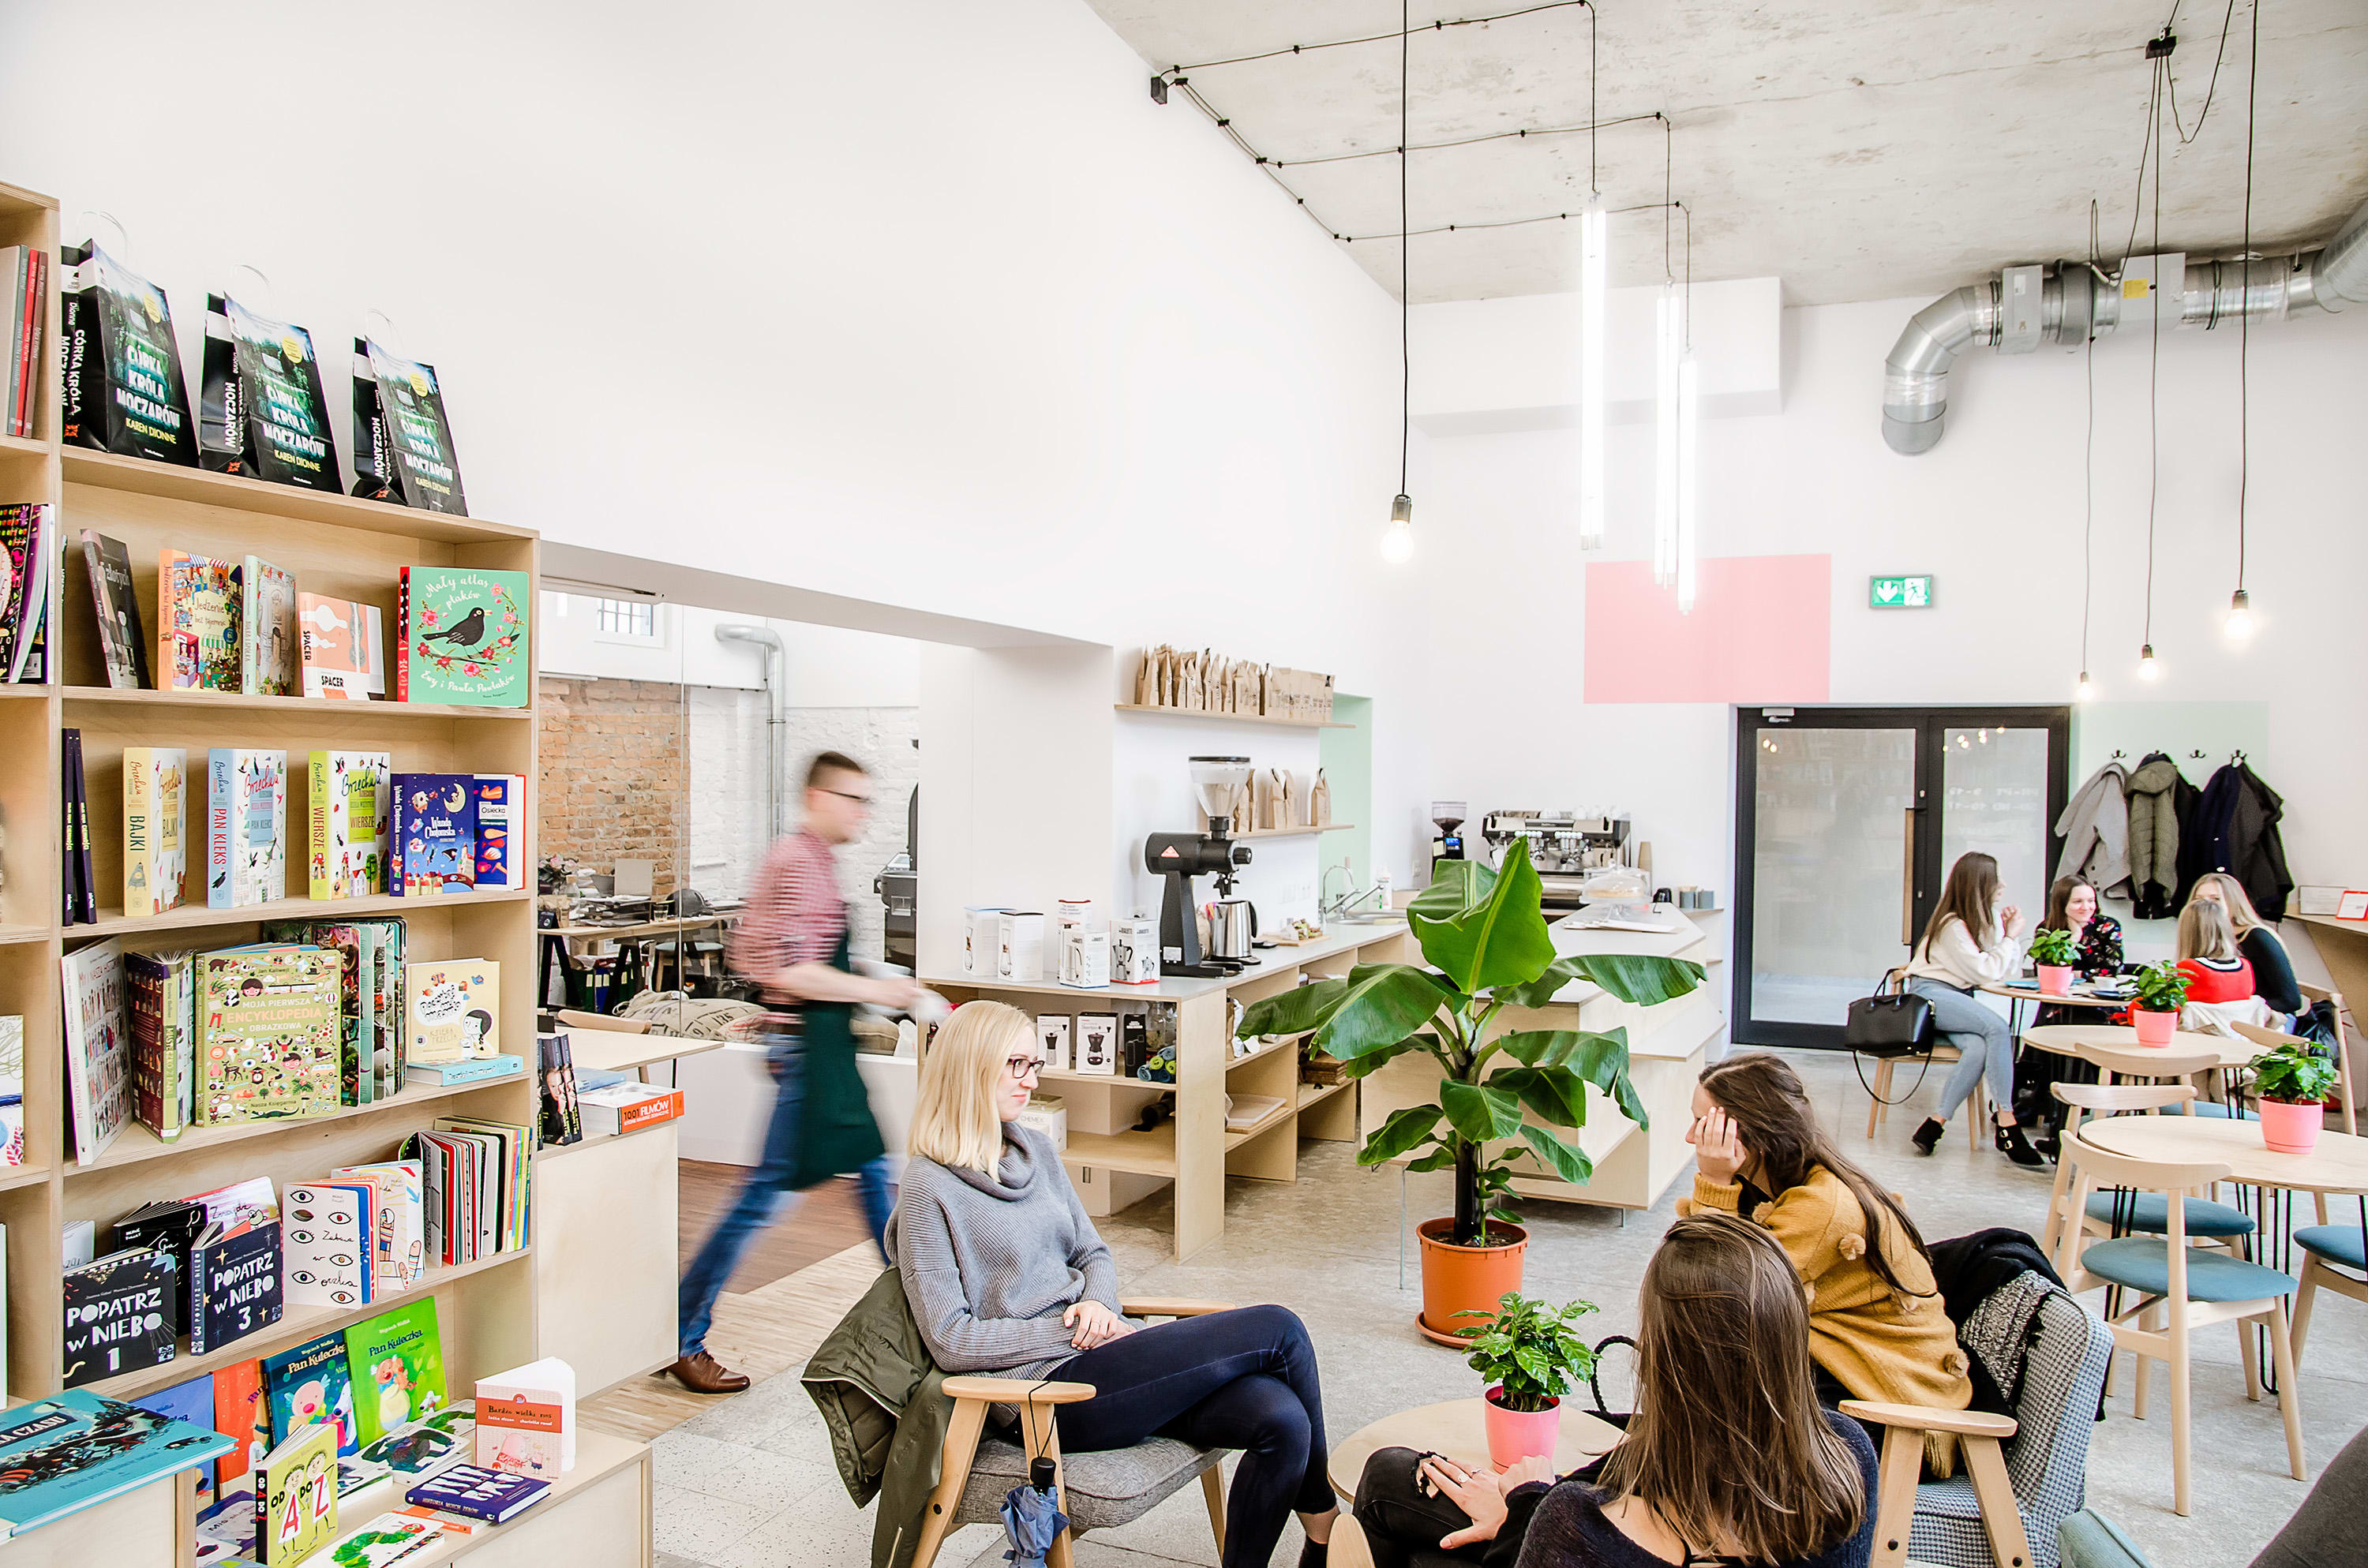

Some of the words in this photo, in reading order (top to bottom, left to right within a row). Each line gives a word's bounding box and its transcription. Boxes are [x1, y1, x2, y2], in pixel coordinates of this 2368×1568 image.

[72, 329, 85, 369] CÓRKA
[126, 345, 163, 376] CÓRKA
[127, 369, 165, 399] KRÓLA
[116, 387, 180, 428] MOCZARÓW
[225, 382, 237, 449] MOCZARÓW
[272, 406, 310, 434] KRÓLA
[126, 416, 148, 435] KAREN
[148, 424, 178, 444] DIONNE
[262, 423, 325, 458] MOCZARÓW
[274, 449, 296, 465] KAREN
[296, 456, 321, 472] DIONNE
[371, 417, 385, 478] MOCZARÓW
[404, 453, 453, 481] MOCZARÓW
[425, 574, 456, 598] Mały
[460, 574, 489, 588] atlas
[195, 597, 225, 614] Jedzenie
[446, 589, 481, 610] ptaków
[303, 630, 312, 661] SPACER
[321, 675, 344, 688] SPACER
[421, 670, 438, 689] Ewy
[440, 679, 444, 688] i
[448, 681, 474, 692] Pawła
[477, 674, 515, 693] Pawlaków
[214, 761, 229, 793] Brzechwa
[244, 765, 280, 798] Brzechwa
[314, 762, 323, 793] Brzechwa
[341, 766, 382, 797] Brzechwa
[394, 785, 403, 804] Wanda
[214, 808, 227, 829] PAN
[313, 807, 325, 849] WIERSZE
[350, 816, 375, 828] WIERSZE
[430, 817, 452, 829] Wanda
[129, 816, 145, 851] BAJKI
[424, 826, 456, 838] Chotomska
[214, 834, 227, 865] KLEKS
[268, 998, 311, 1007] PIERWSZA
[227, 1008, 322, 1024] ENCYKLOPEDIA
[249, 1022, 301, 1033] OBRAZKOWA
[712, 1012, 734, 1026] 135
[165, 1027, 174, 1069] MIASTECZKO
[624, 1108, 639, 1120] 1001
[640, 1100, 669, 1116] FILMÓW
[322, 1230, 354, 1243] Zabawa
[214, 1251, 274, 1292] POPATRZ
[214, 1298, 227, 1314] w
[230, 1274, 275, 1308] NIEBO
[67, 1287, 163, 1328] POPATRZ
[238, 1305, 251, 1330] 3
[67, 1335, 88, 1353] w
[92, 1312, 163, 1346] NIEBO
[194, 1326, 202, 1336] 3
[369, 1345, 386, 1357] Pan
[387, 1328, 423, 1349] Kuleczka
[107, 1347, 120, 1372] 1
[287, 1357, 307, 1375] Pan
[488, 1405, 512, 1415] Bardzo
[12, 1415, 67, 1436] CZASU
[258, 1477, 266, 1489] OD
[257, 1502, 265, 1513] DO
[271, 1491, 285, 1508] OD
[282, 1494, 299, 1538] A
[300, 1481, 313, 1499] DO
[315, 1474, 329, 1518] Z
